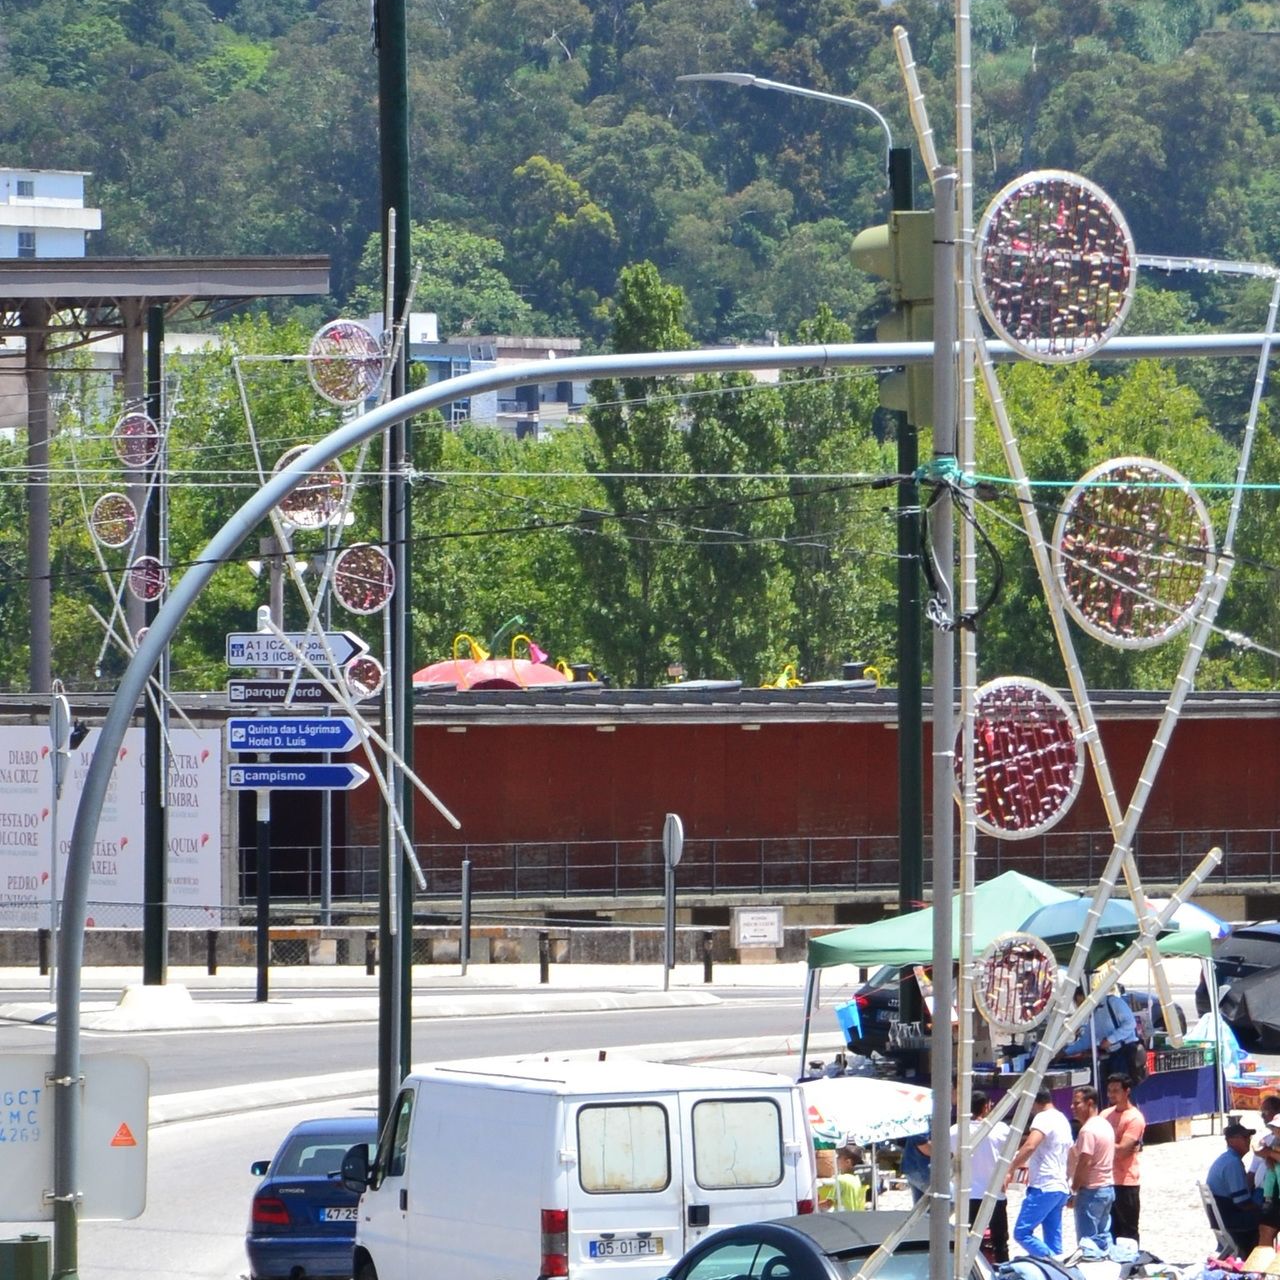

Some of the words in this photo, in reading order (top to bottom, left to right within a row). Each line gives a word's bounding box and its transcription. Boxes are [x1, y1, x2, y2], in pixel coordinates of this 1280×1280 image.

[246, 640, 261, 650] A1
[246, 651, 269, 661] A13
[245, 687, 286, 699] parque
[248, 724, 278, 735] Quinta
[280, 724, 297, 734] das
[299, 724, 341, 737] Lágrimas
[248, 736, 272, 746] Hotel
[9, 750, 38, 765] DIABO
[14, 769, 38, 783] CRUZ
[245, 770, 306, 783] campismo
[25, 813, 38, 828] DO
[8, 875, 38, 889] PEDRO
[0, 1110, 37, 1124] MC
